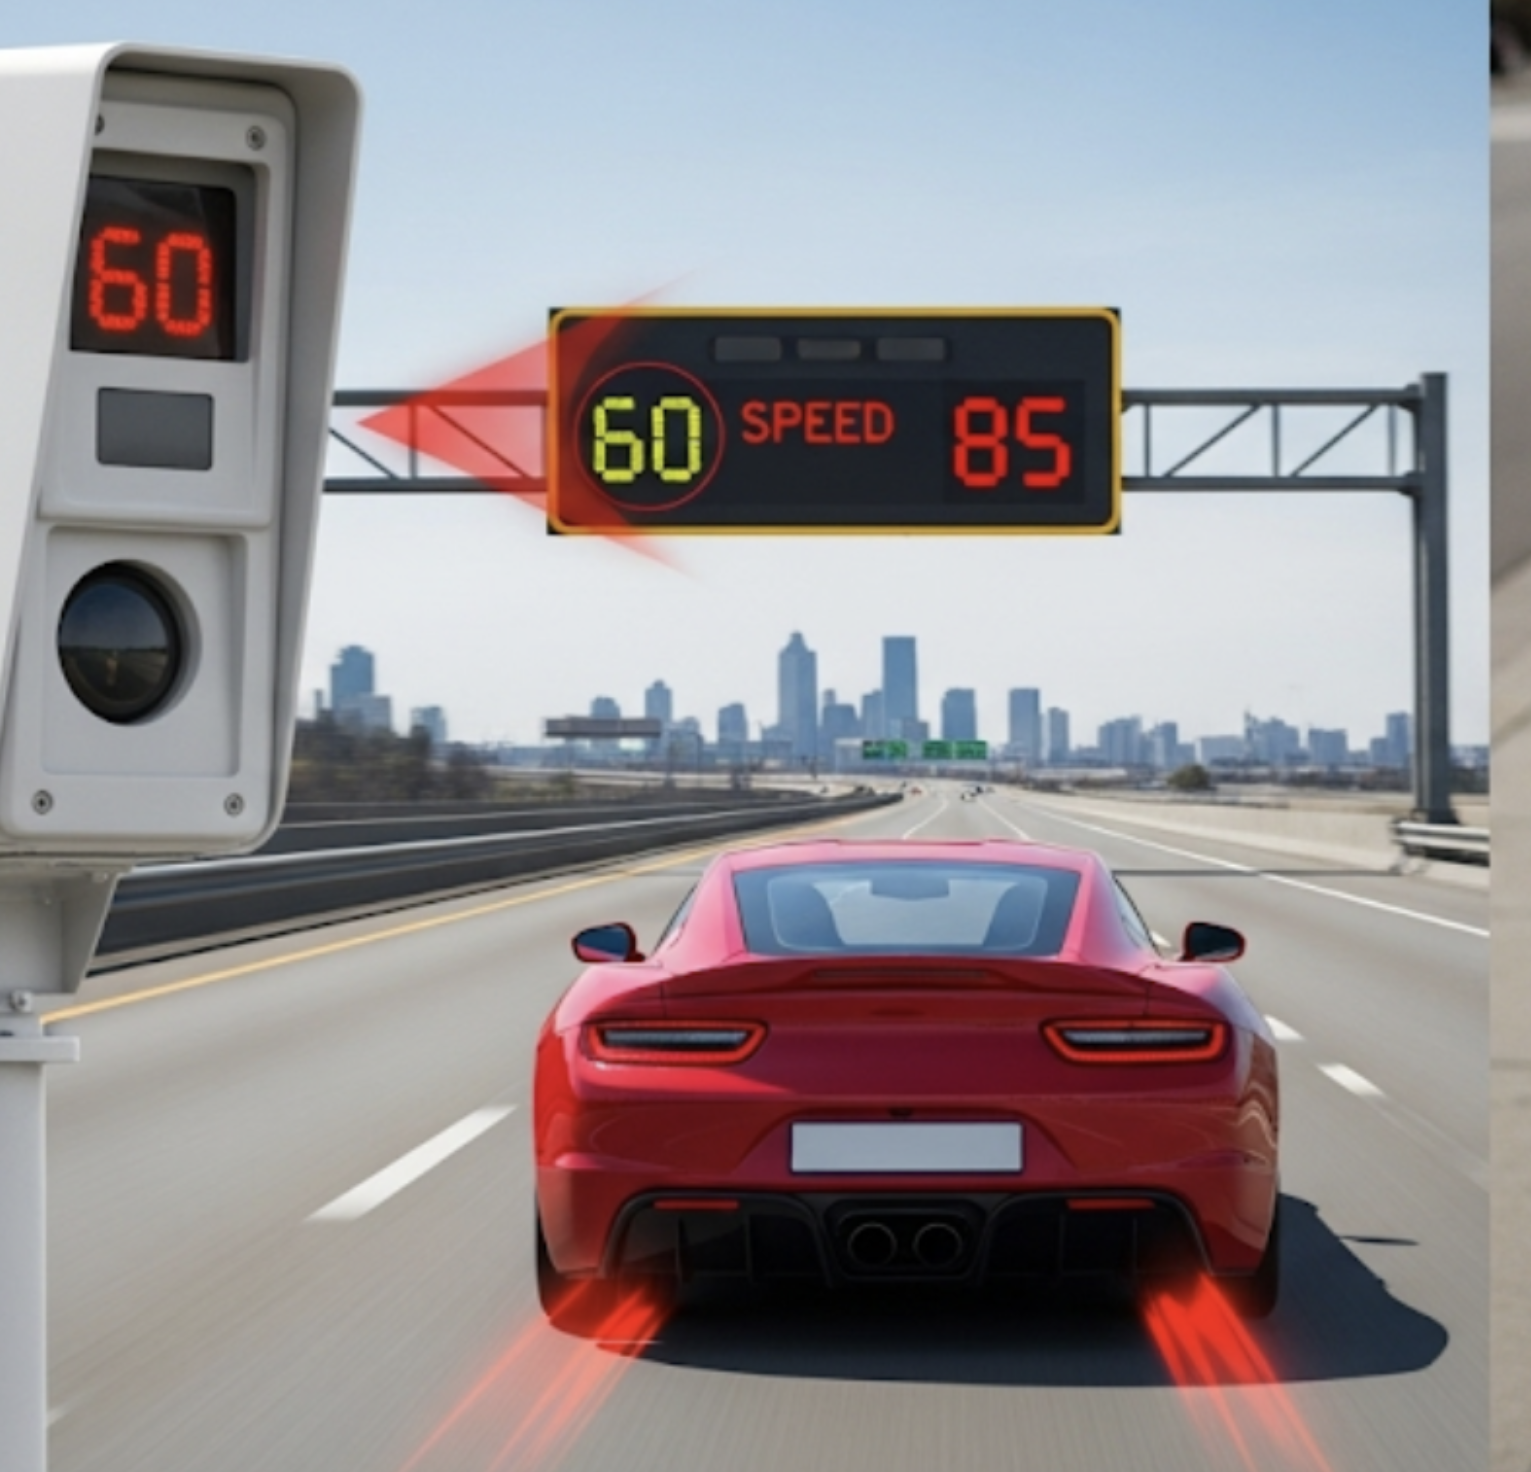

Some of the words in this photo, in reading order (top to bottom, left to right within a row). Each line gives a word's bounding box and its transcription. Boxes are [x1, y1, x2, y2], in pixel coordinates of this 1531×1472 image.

[90, 227, 212, 337] 60
[593, 396, 701, 482] 60
[741, 402, 894, 444] SPEED
[954, 398, 1071, 487] 85
